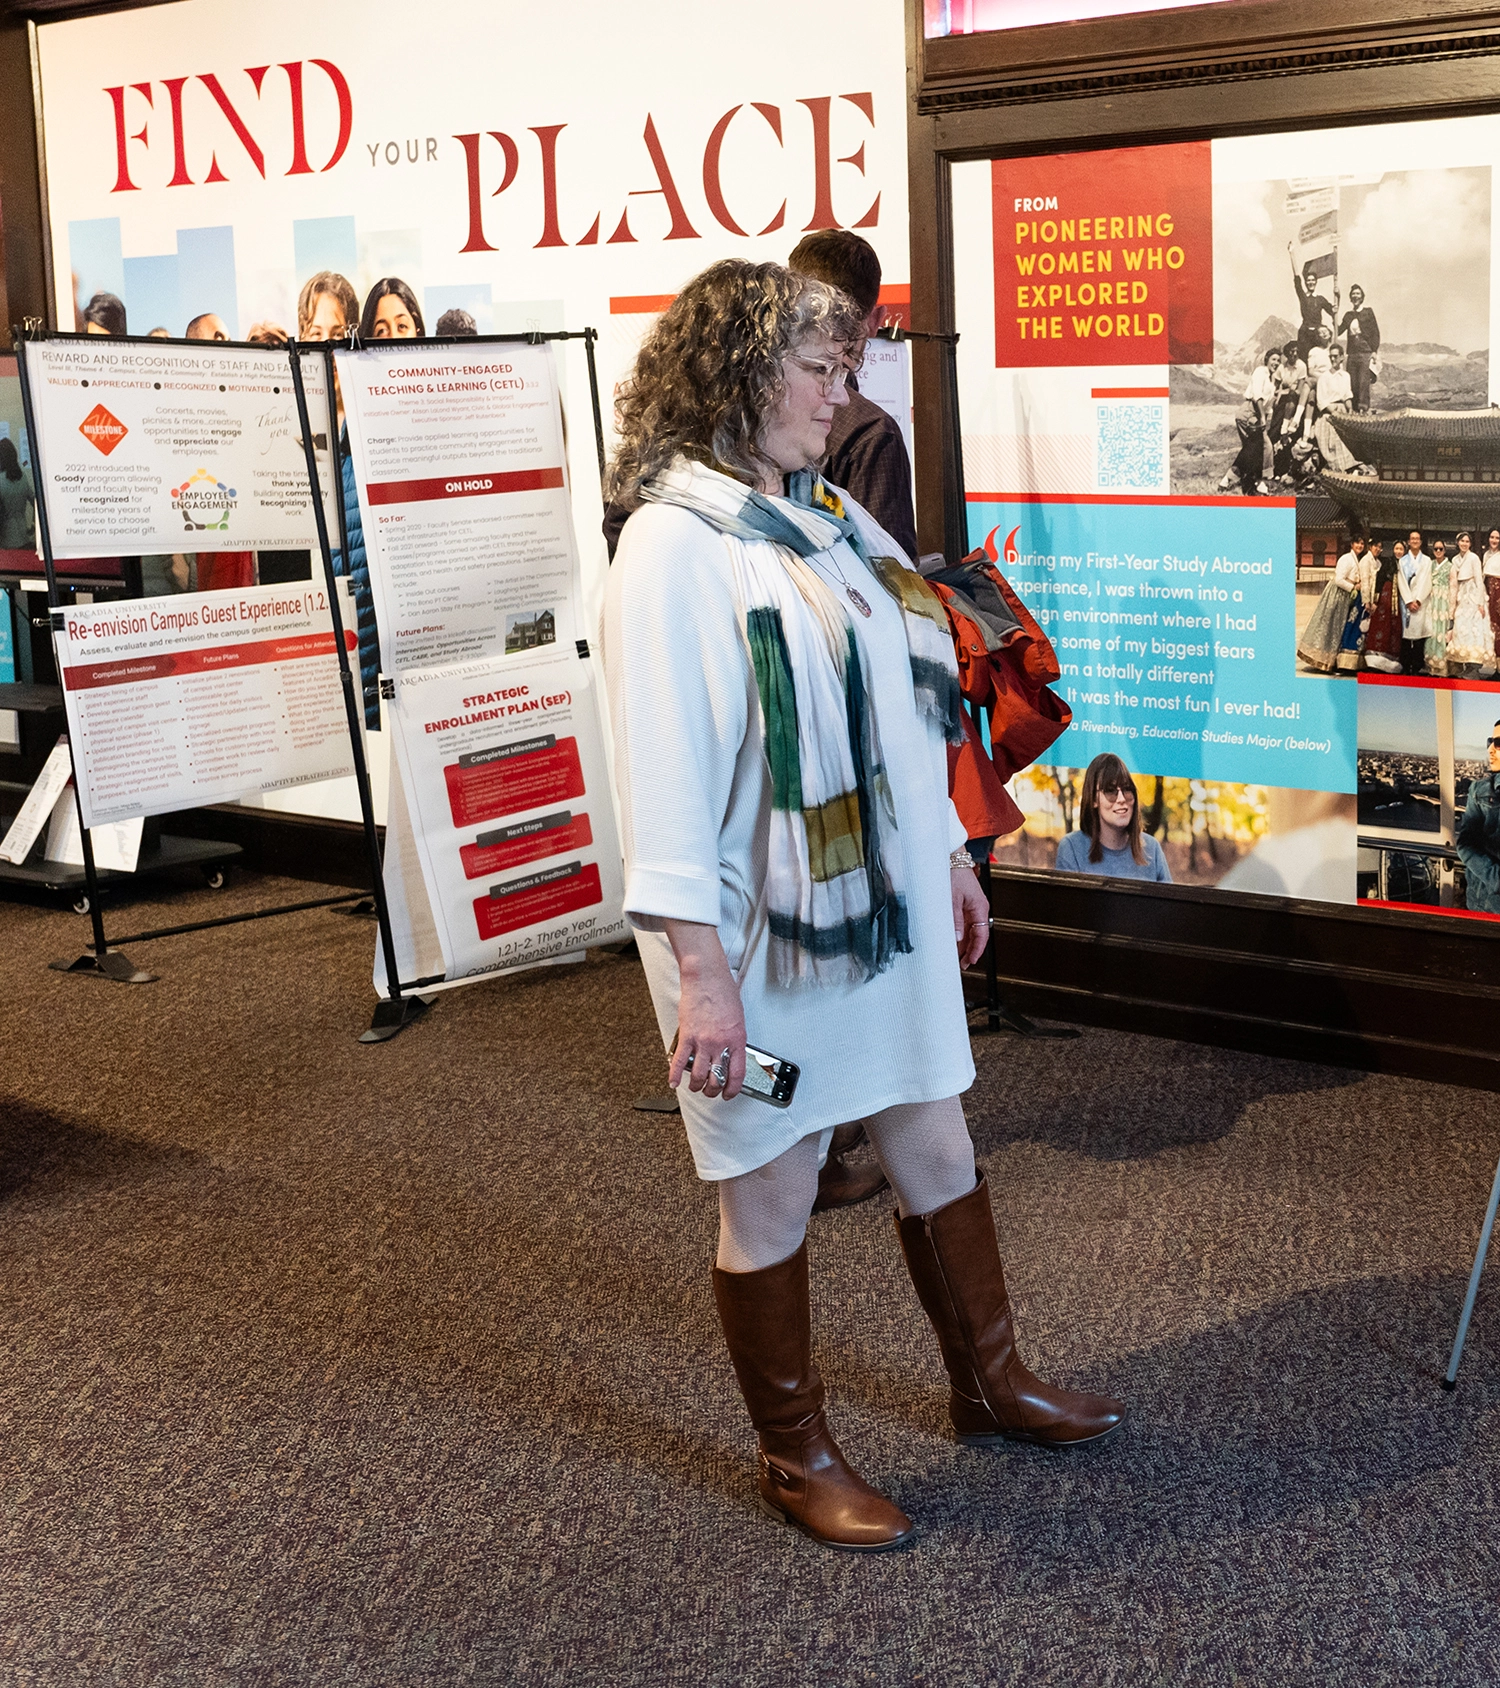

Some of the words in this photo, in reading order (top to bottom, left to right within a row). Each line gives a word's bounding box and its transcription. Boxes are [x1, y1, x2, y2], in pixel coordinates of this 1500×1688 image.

[103, 58, 353, 193] FIND
[366, 136, 439, 168] YOUR
[451, 91, 882, 254] PLACE
[1014, 196, 1058, 212] FROM
[1015, 213, 1174, 244] PIONEERING
[1016, 250, 1113, 276] WOMEN
[1122, 246, 1185, 270] WHO
[1017, 281, 1148, 308] EXPLORED
[1017, 318, 1063, 339] THE
[1072, 313, 1165, 338] WORLD
[42, 351, 89, 364] REWARD
[94, 355, 118, 364] AND
[122, 356, 199, 369] RECOGNITION
[203, 359, 216, 369] OF
[220, 360, 249, 370] STAFF
[253, 362, 275, 372] AND
[388, 364, 513, 378] COMMUNITY-ENGAGED
[47, 378, 78, 386] VALUED
[92, 380, 151, 389] APPRECIATED
[164, 382, 217, 391] RECOGNIZED
[228, 385, 271, 393] MOTIVATED
[368, 386, 424, 396] TEACHING
[427, 384, 434, 393] &
[436, 382, 487, 393] LEARNING
[490, 377, 525, 392] (CETL)
[83, 424, 124, 436] MILESTONE
[211, 429, 242, 437] engage
[173, 438, 219, 447] appreciate
[54, 475, 85, 483] Goody
[445, 482, 461, 493] ON
[463, 479, 493, 490] HOLD
[80, 496, 129, 505] recognized
[172, 501, 238, 510] ENGAGEMENT
[180, 492, 228, 500] EMPLOYEE
[1007, 550, 1056, 571] During
[1060, 557, 1082, 571] my
[1087, 552, 1159, 571] First-Year
[1163, 555, 1208, 577] Study
[1211, 556, 1272, 575] Abroad
[1007, 576, 1092, 598] Experience,
[1096, 581, 1100, 596] I
[1105, 584, 1135, 597] was
[1139, 582, 1194, 600] thrown
[1198, 584, 1228, 602] into
[1232, 589, 1243, 602] a
[68, 614, 147, 641] Re-envision
[151, 611, 199, 632] Campus
[202, 603, 237, 624] Guest
[240, 598, 301, 623] Experience
[1063, 607, 1158, 626] environment
[1162, 611, 1212, 629] where
[1216, 613, 1220, 629] I
[1225, 613, 1257, 631] had
[115, 642, 147, 651] evaluate
[149, 638, 163, 647] and
[165, 634, 205, 645] re-envision
[221, 629, 249, 638] campus
[252, 626, 272, 635] guest
[1062, 637, 1101, 650] some
[1105, 635, 1121, 650] of
[1124, 640, 1147, 657] my
[1152, 638, 1209, 660] biggest
[1214, 641, 1255, 660] fears
[1083, 664, 1092, 677] a
[1096, 663, 1143, 684] totally
[1147, 665, 1214, 684] different
[463, 686, 529, 708] STRATEGIC
[1067, 687, 1077, 702] It
[1081, 692, 1110, 706] was
[1114, 691, 1138, 707] the
[1143, 696, 1180, 710] most
[1185, 695, 1210, 712] fun
[1215, 698, 1219, 713] I
[1224, 702, 1259, 716] ever
[1263, 700, 1300, 720] had!
[424, 707, 505, 734] ENROLLMENT
[508, 700, 539, 715] PLAN
[541, 690, 572, 710] (SEP)
[1082, 721, 1139, 739] Rivenburg,
[1142, 725, 1198, 741] Education
[1201, 730, 1243, 745] Studies
[1246, 734, 1282, 750] Major
[1285, 736, 1331, 754] (below)
[470, 748, 510, 763] Completed
[510, 739, 548, 754] Milestones
[507, 828, 523, 837] Next
[524, 822, 543, 833] Steps
[500, 880, 534, 894] Questions
[541, 868, 572, 882] Feedback
[537, 931, 568, 944] Three
[572, 917, 597, 932] Year
[565, 919, 625, 947] Enrollment
